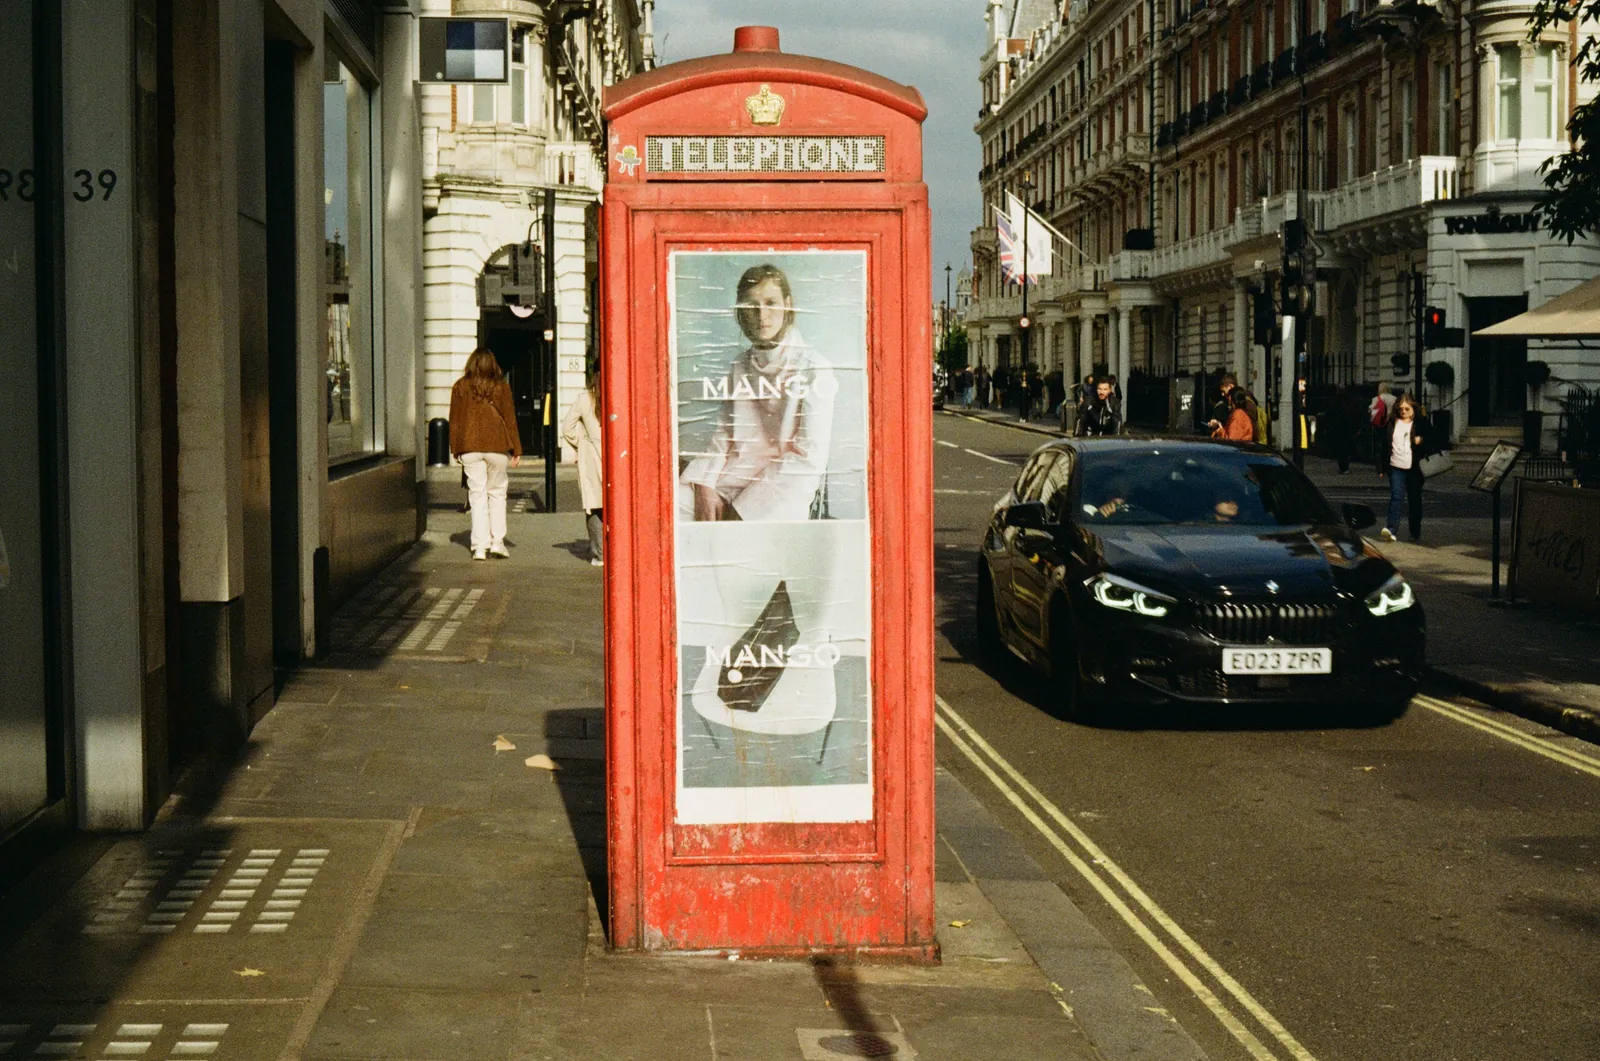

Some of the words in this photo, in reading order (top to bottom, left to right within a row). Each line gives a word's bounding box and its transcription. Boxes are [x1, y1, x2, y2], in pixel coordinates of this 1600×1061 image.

[658, 137, 878, 171] TELEPHONE
[73, 169, 117, 202] 39
[568, 358, 579, 370] 88
[702, 374, 839, 401] MANGO
[705, 643, 841, 668] MANGO
[1287, 652, 1321, 669] ZPR
